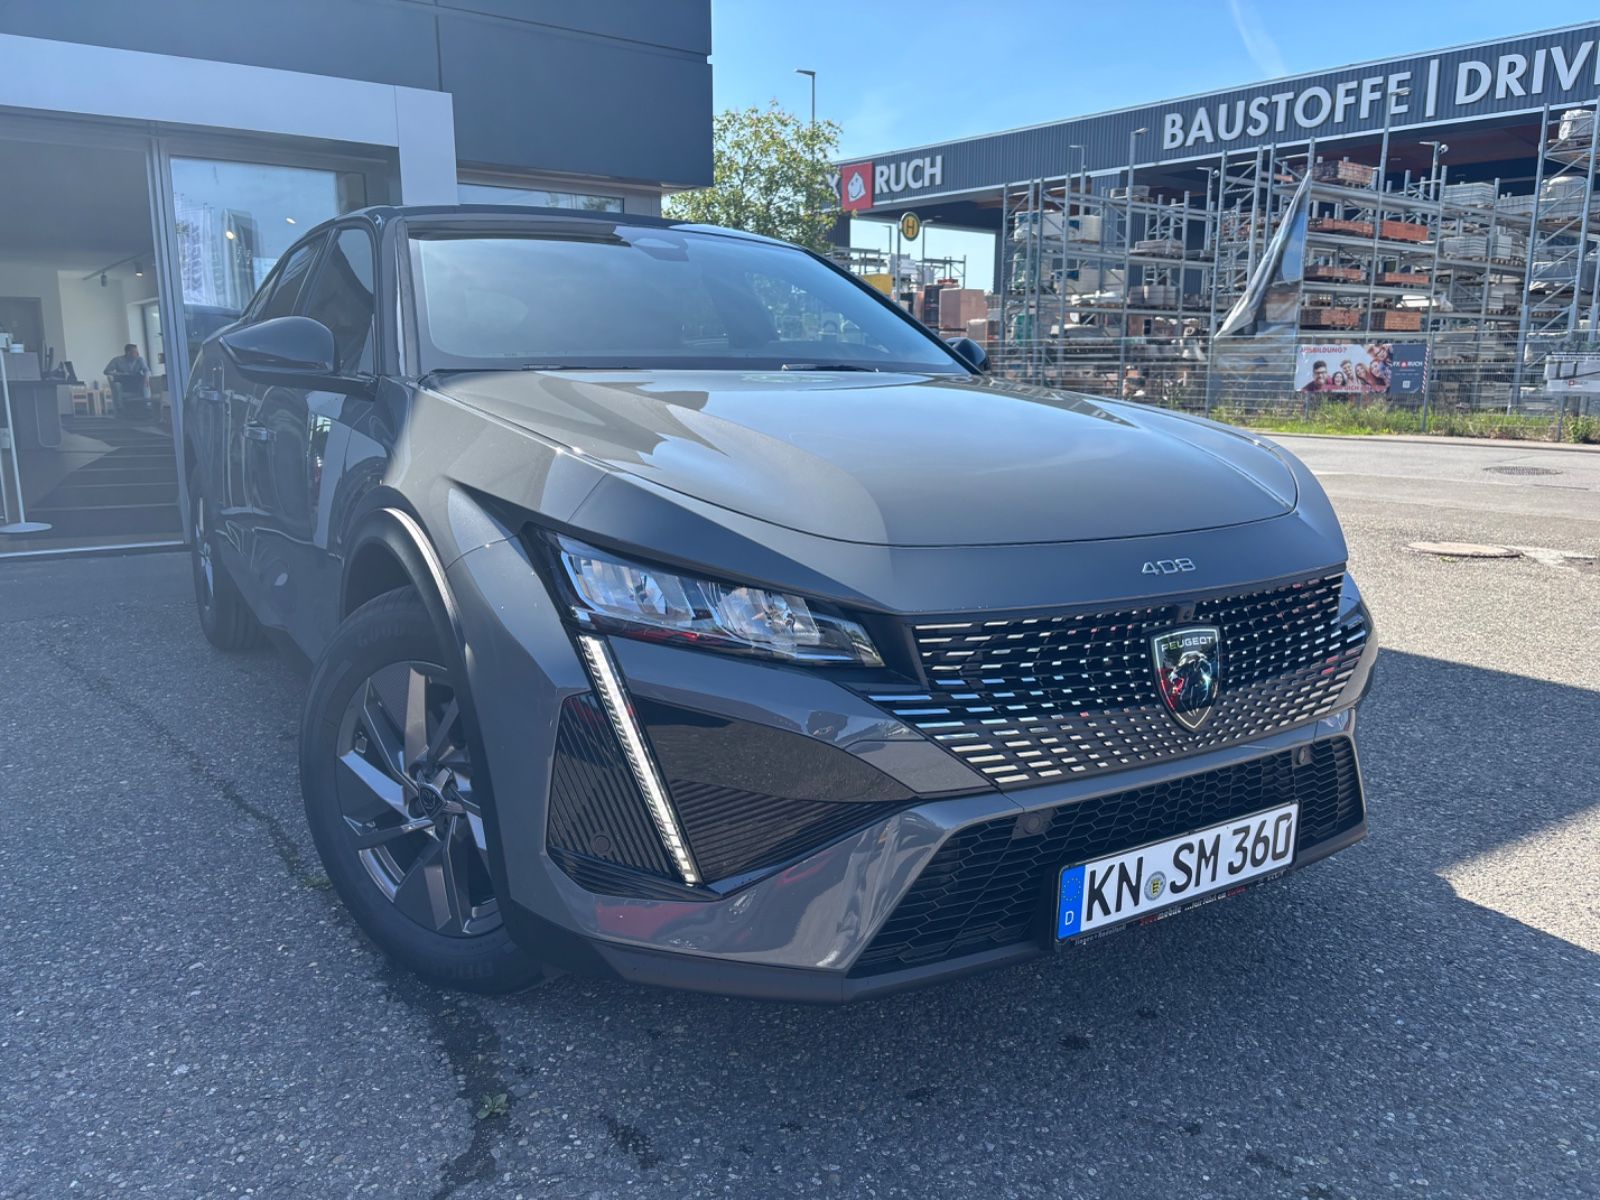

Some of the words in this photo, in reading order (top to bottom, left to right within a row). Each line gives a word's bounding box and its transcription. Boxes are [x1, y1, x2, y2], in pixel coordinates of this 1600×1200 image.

[1163, 71, 1412, 150] BAUSTOFFE
[1455, 40, 1600, 105] DRIV
[875, 155, 943, 194] RUCH
[906, 219, 915, 236] H
[1141, 558, 1196, 575] 408
[1161, 636, 1213, 652] PEUGEOT
[1065, 911, 1074, 925] D
[1086, 856, 1143, 922] KN
[1169, 834, 1221, 895] SM
[1227, 812, 1293, 876] 360
